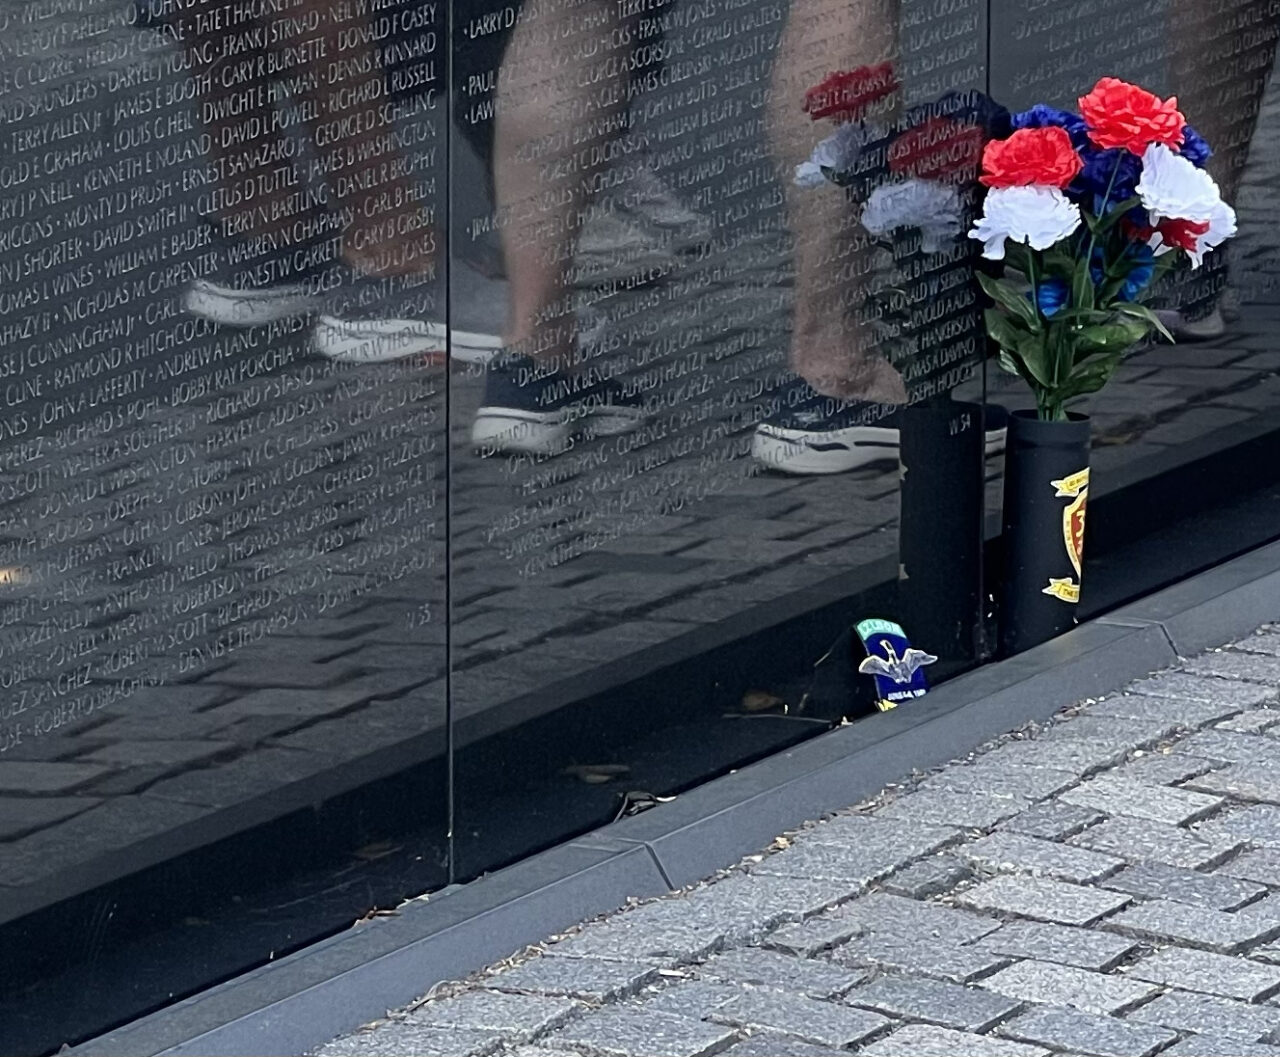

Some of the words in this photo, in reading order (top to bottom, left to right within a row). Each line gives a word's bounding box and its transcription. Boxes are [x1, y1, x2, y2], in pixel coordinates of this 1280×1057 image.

[114, 90, 154, 125] JAMES
[156, 87, 162, 109] E
[166, 72, 212, 106] BOOTH
[258, 55, 266, 77] R
[268, 36, 327, 74] BURNETTE
[338, 17, 390, 52] DONALD
[393, 14, 399, 35] F
[401, 3, 436, 33] CASEY
[166, 41, 213, 75] YOUNG
[223, 26, 262, 57] FRANK
[272, 9, 320, 42] STRNAD
[196, 8, 222, 36] TATE
[204, 88, 257, 124] DWIGHT
[259, 85, 264, 107] E
[329, 52, 372, 84] DENNIS
[374, 49, 382, 70] R
[385, 31, 436, 66] KINNARD
[222, 116, 261, 148] DAVID
[264, 113, 270, 134] L
[272, 97, 320, 131] POWELL
[329, 78, 380, 113] RICHARD
[384, 75, 390, 95] L
[393, 60, 436, 93] RUSSELL
[65, 194, 115, 231] MONTY
[117, 190, 127, 214] D
[131, 176, 171, 209] PRUSH
[183, 158, 225, 192] ERNEST
[229, 136, 295, 177] SANAZARO
[198, 183, 241, 217] CLETUS
[244, 178, 254, 201] D
[258, 163, 299, 196] TUTTLE
[308, 148, 344, 181] JAMES
[347, 144, 355, 166] B
[357, 117, 436, 162] WASHINGTON
[25, 236, 83, 275] SHORTER
[64, 281, 130, 324] NICHOLAS
[134, 275, 145, 299] M
[149, 250, 218, 294] CARPENTER
[228, 229, 279, 266] WARREN
[281, 225, 291, 248] N
[293, 204, 353, 244] CHAPMAN
[39, 394, 72, 429] JOHN
[75, 389, 86, 413] A
[90, 367, 145, 407] LAFFERTY
[156, 343, 212, 383] ANDREW
[214, 339, 223, 362] A
[225, 326, 258, 357] LANG
[172, 372, 213, 407] BOBBY
[215, 363, 238, 391] RAY
[240, 343, 293, 382] PORCHIA
